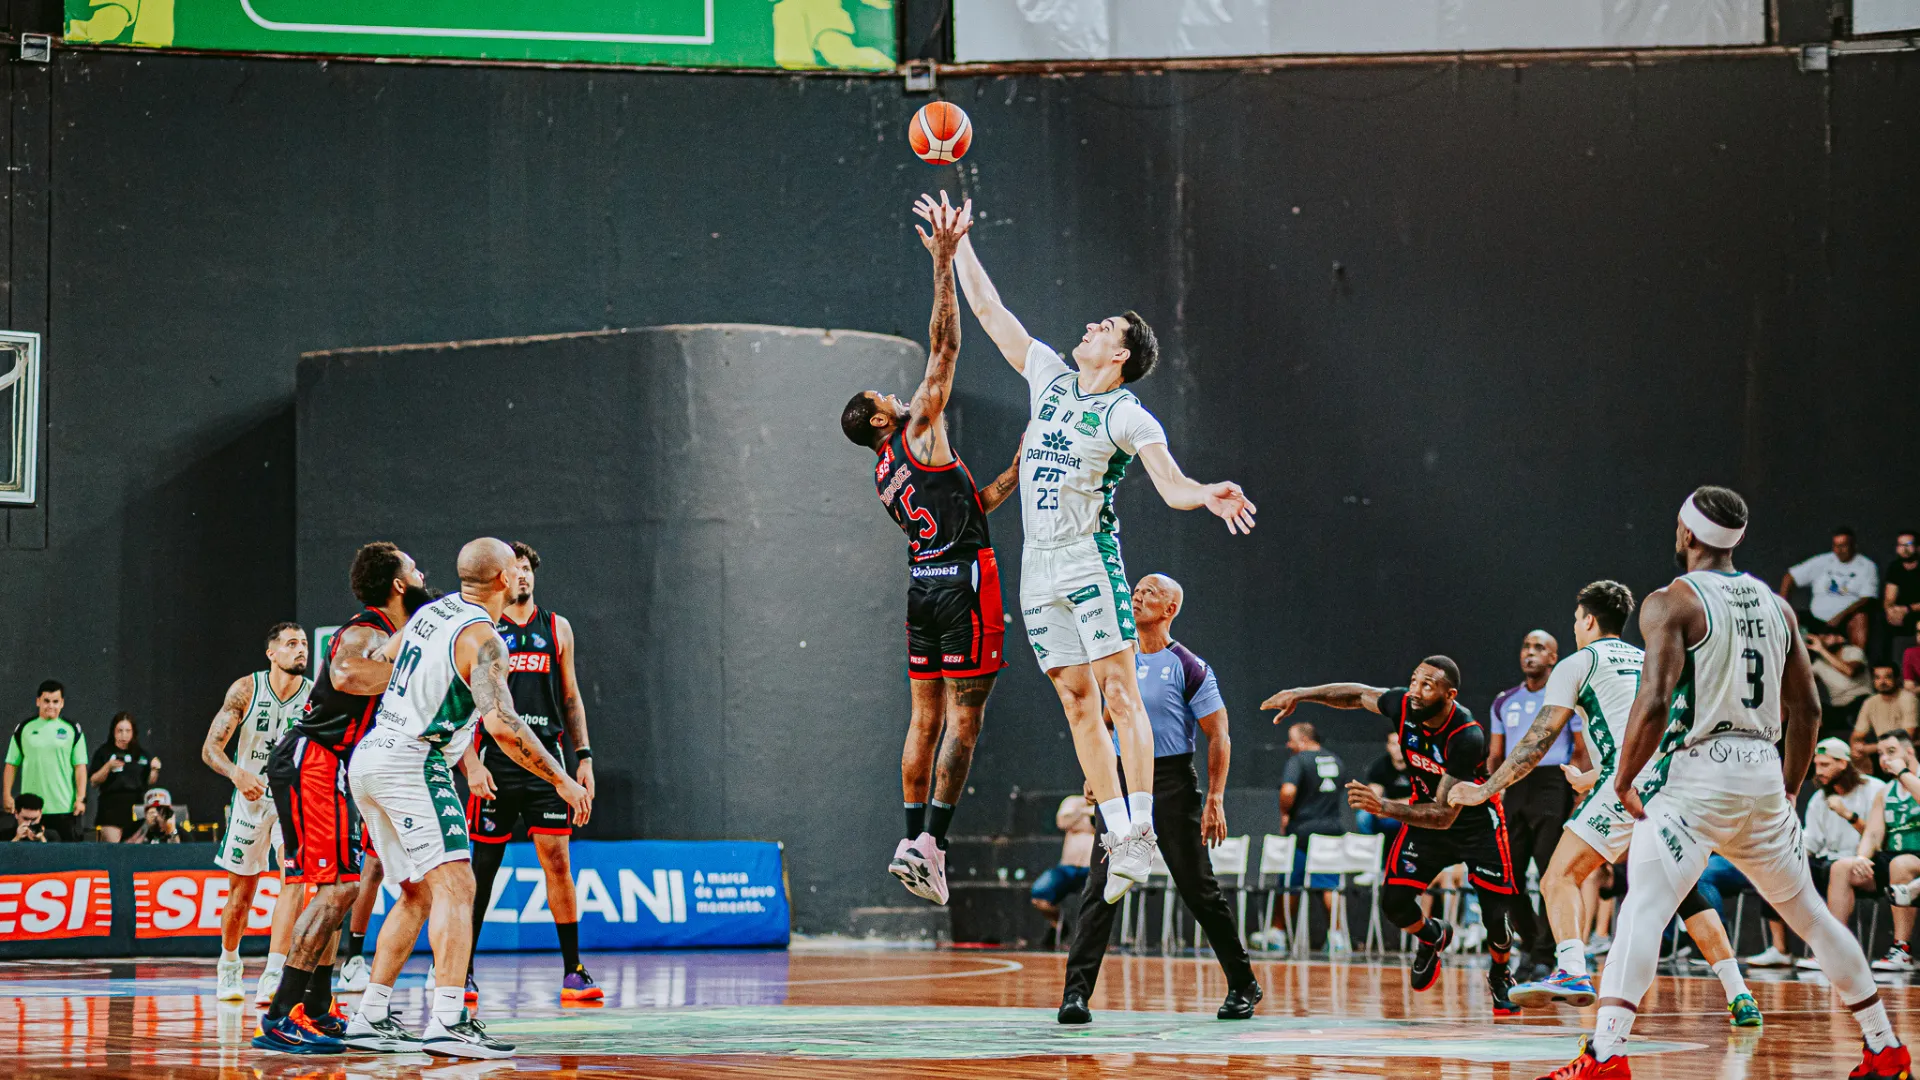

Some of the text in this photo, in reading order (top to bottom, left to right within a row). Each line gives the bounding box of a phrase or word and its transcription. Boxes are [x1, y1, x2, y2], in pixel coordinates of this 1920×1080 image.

[1026, 448, 1082, 470] parmalat
[1037, 488, 1059, 510] 23
[411, 618, 439, 641] ALEX
[388, 640, 422, 698] 10
[509, 654, 547, 672] SESI
[1741, 648, 1764, 710] 3
[693, 869, 748, 884] A marca
[695, 884, 713, 899] de
[716, 887, 738, 899] um
[153, 876, 281, 931] SES
